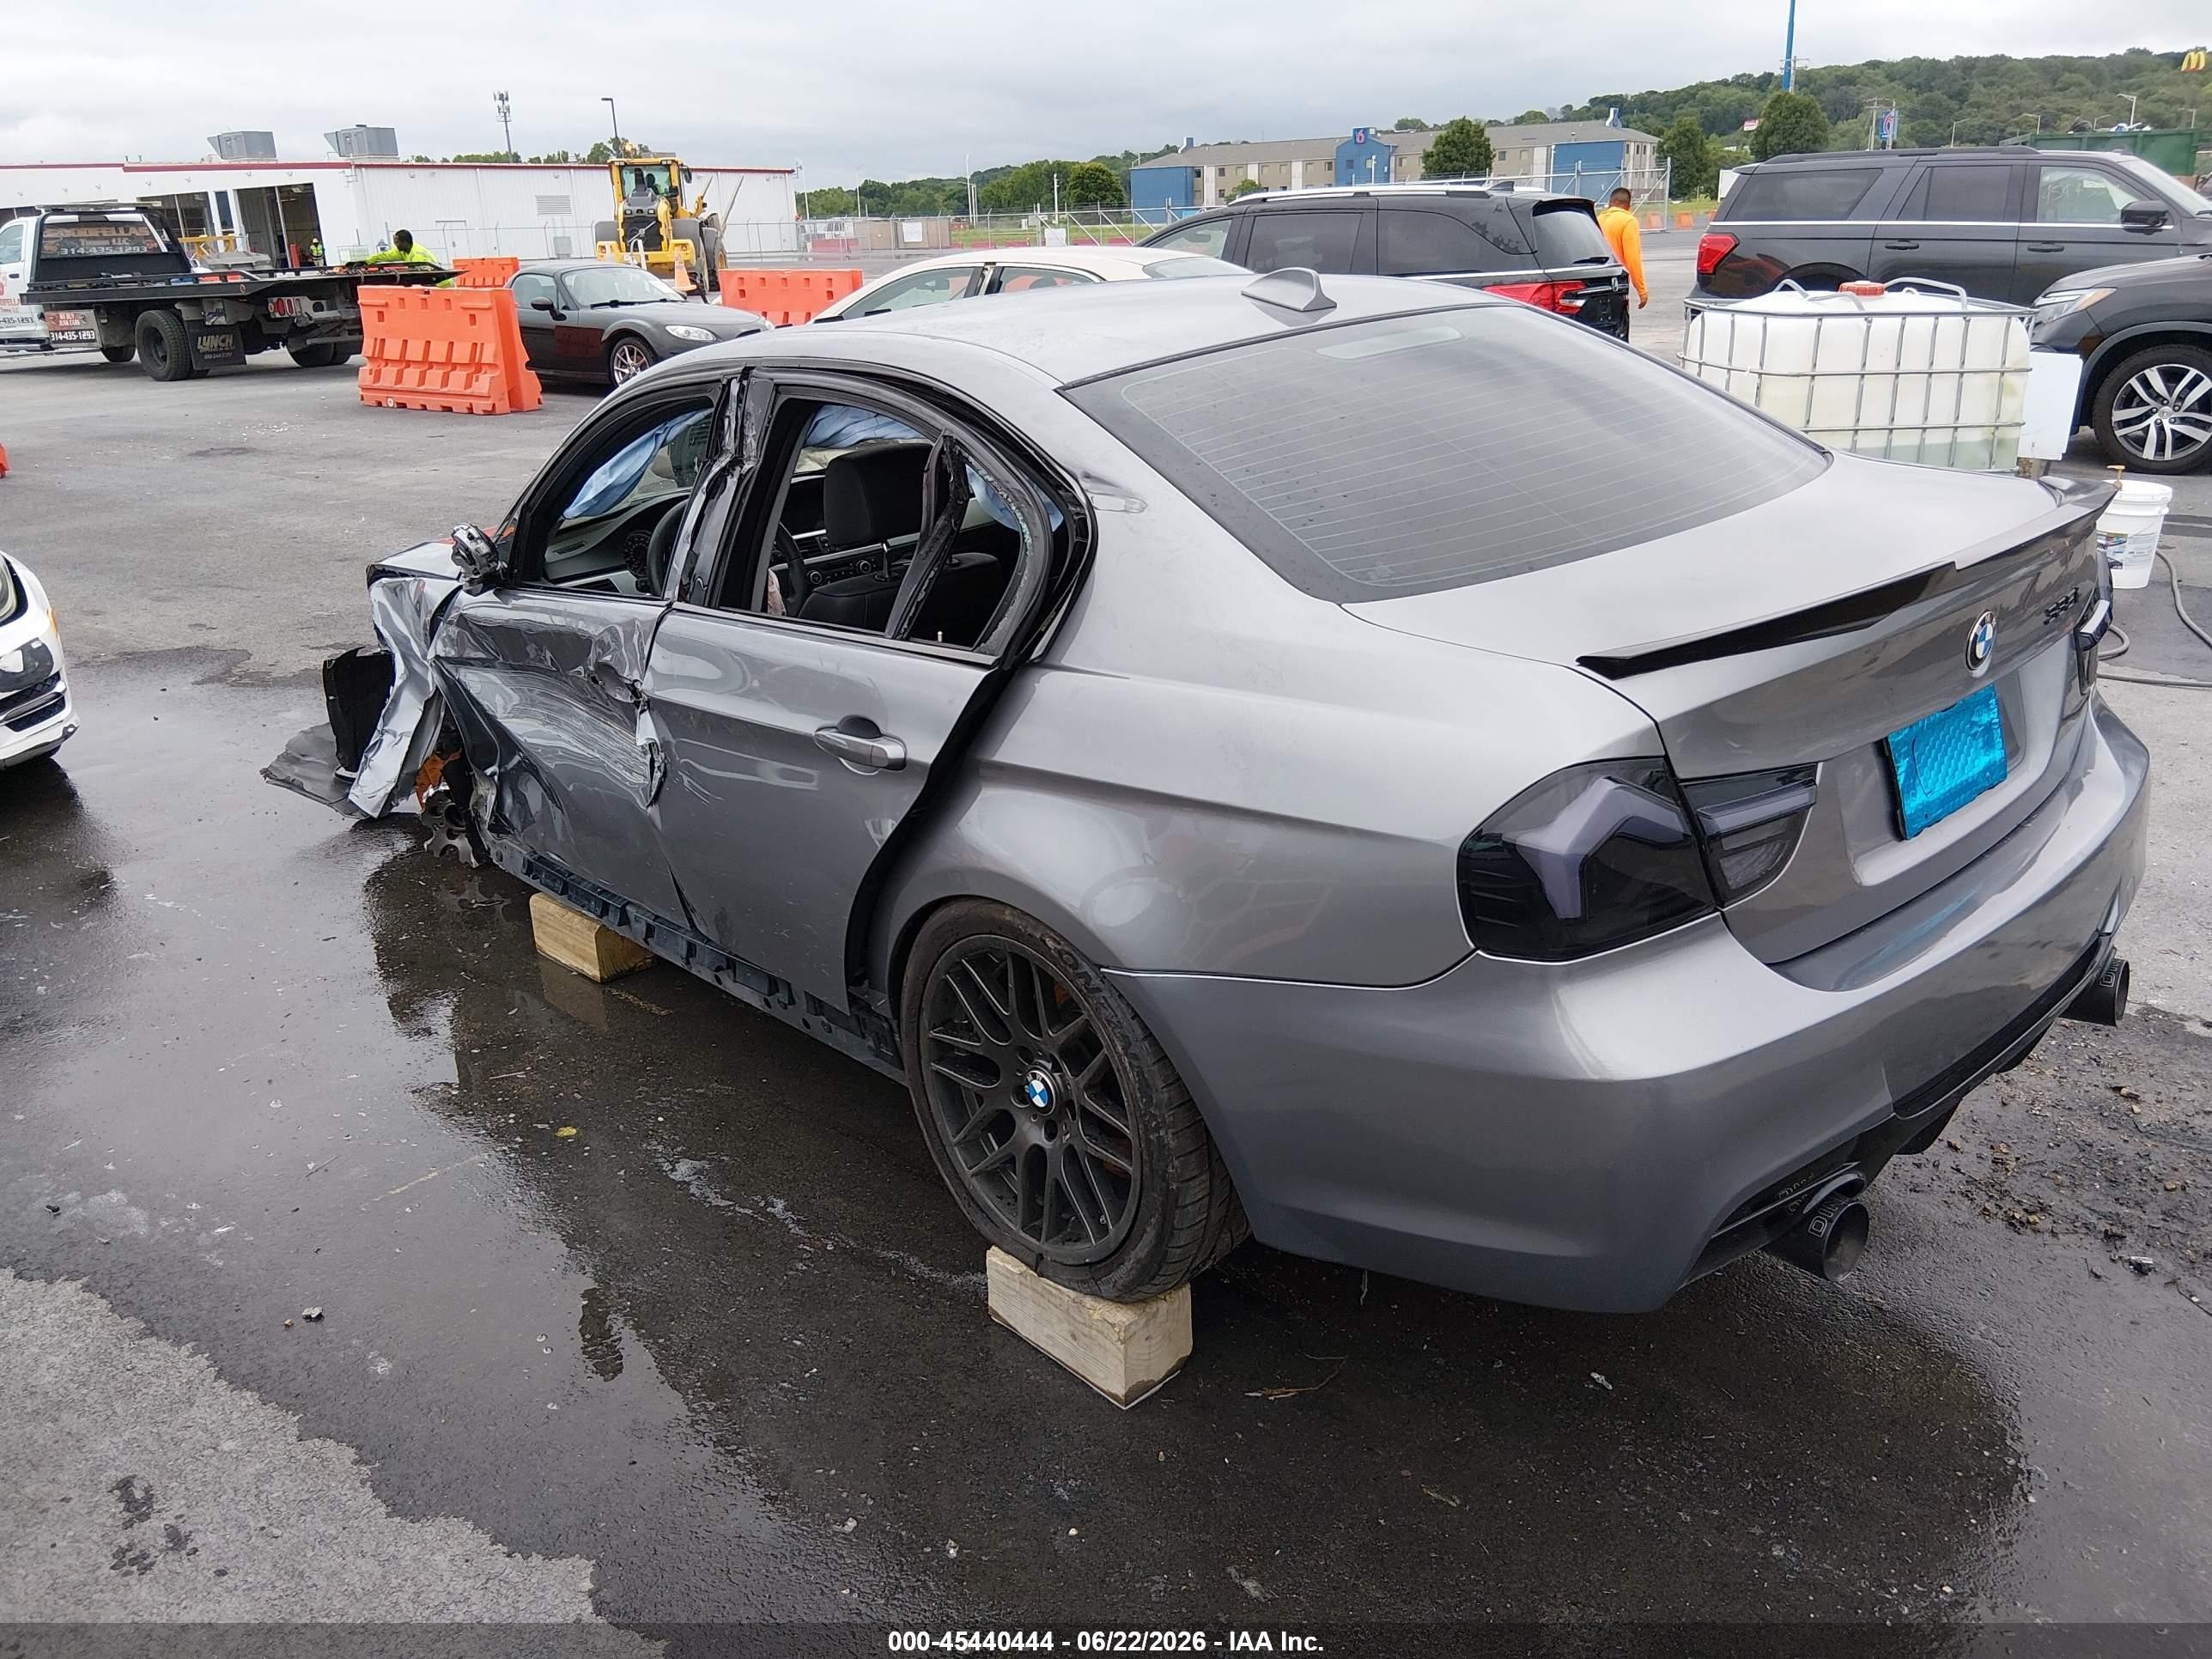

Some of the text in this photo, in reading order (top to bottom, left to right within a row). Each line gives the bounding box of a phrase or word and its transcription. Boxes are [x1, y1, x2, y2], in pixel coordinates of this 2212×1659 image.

[1356, 129, 1365, 143] 6
[50, 330, 95, 341] 314-435-1293
[198, 334, 233, 349] LYNCH
